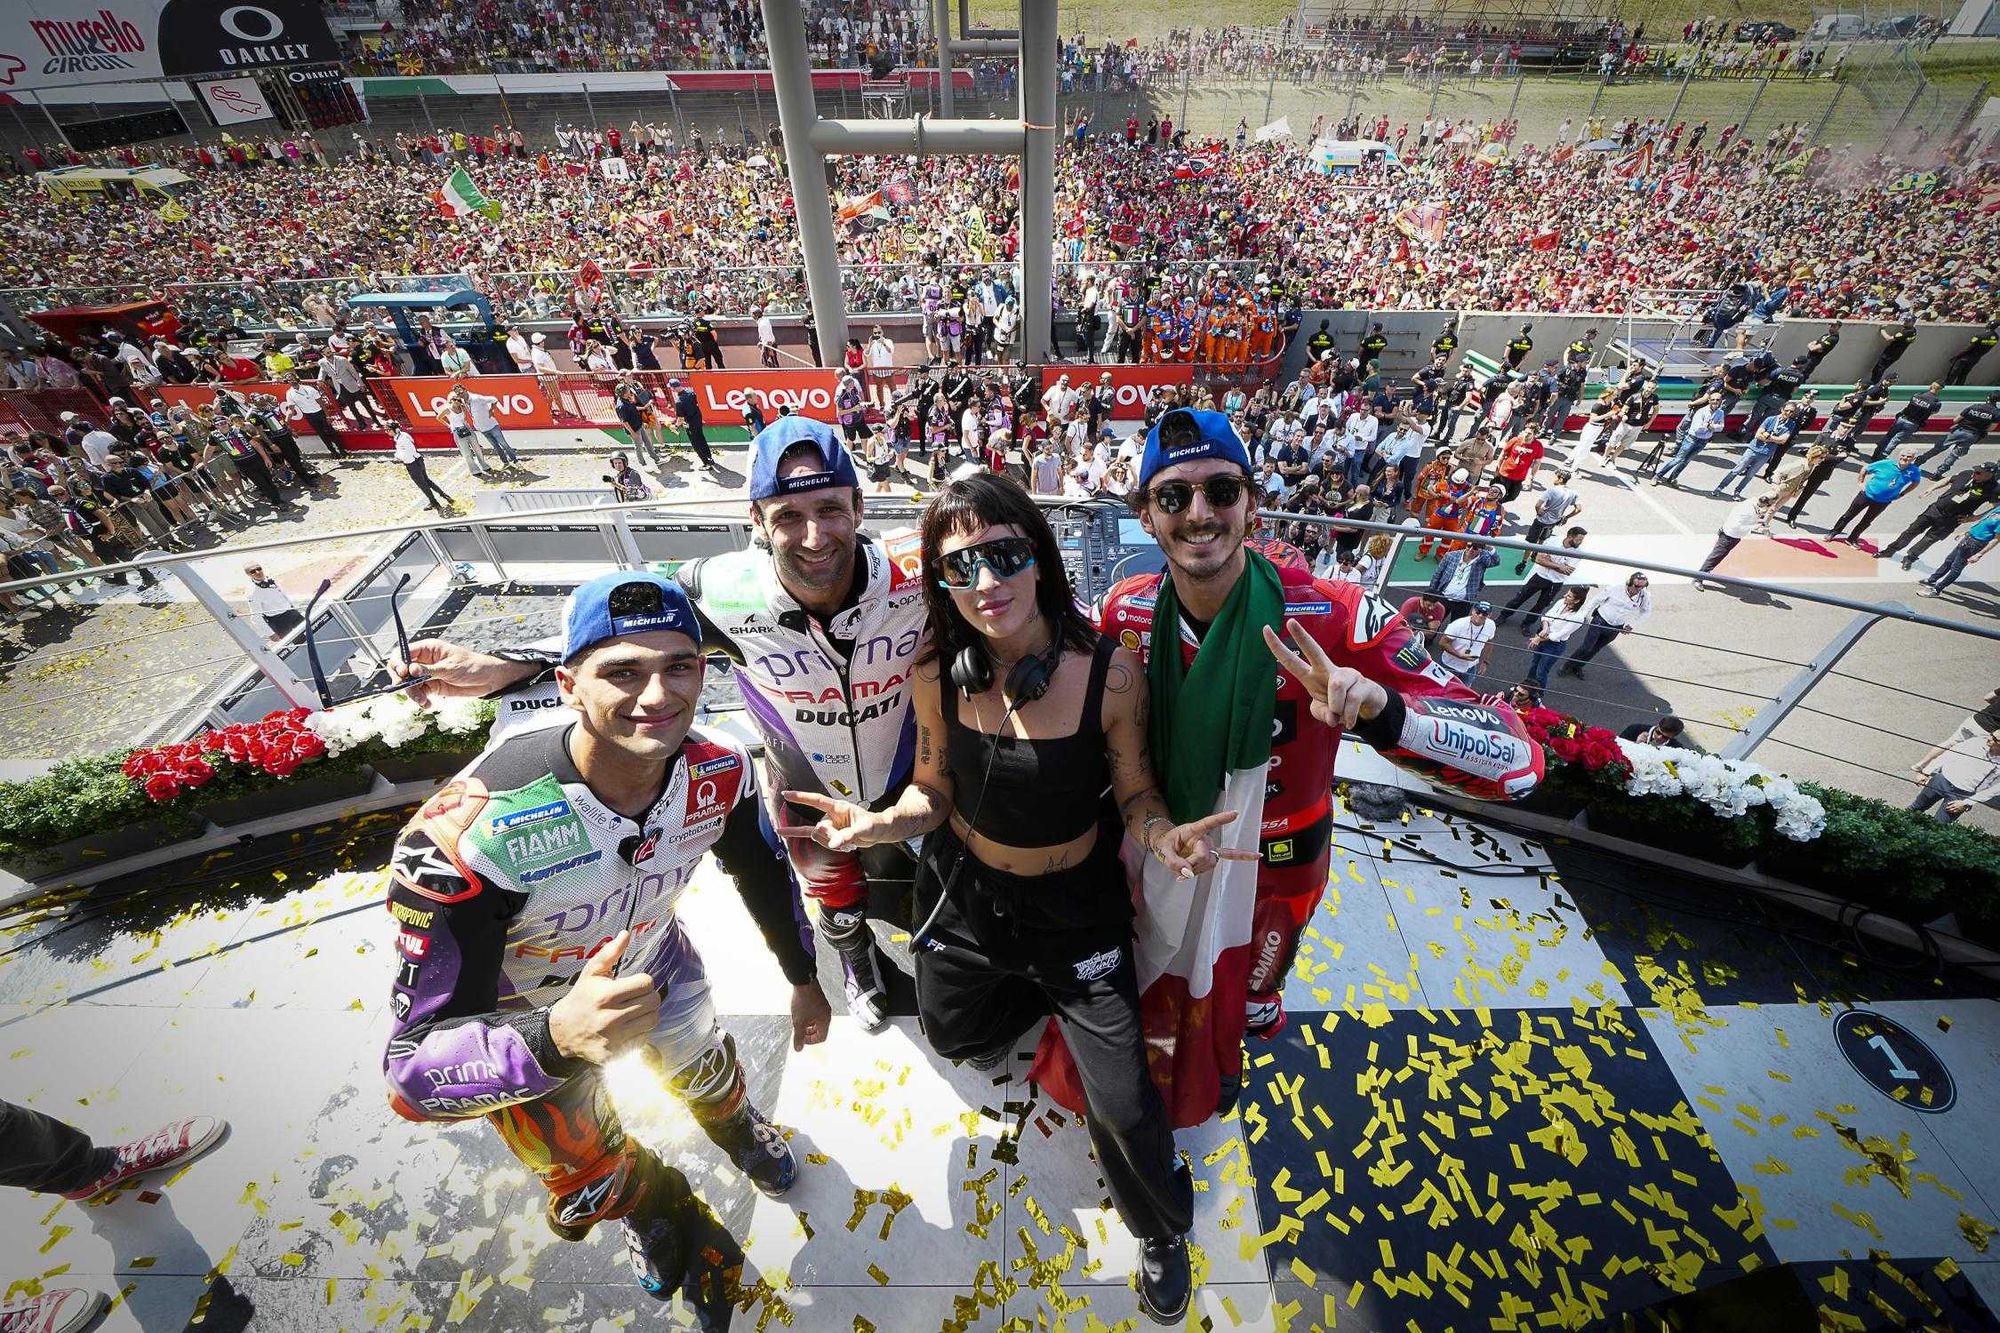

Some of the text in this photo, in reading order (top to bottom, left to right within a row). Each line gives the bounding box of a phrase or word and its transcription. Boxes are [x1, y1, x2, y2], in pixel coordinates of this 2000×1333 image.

[28, 10, 145, 56] mugello
[42, 54, 135, 75] CIRCUIT
[219, 44, 310, 65] OAKLEY
[305, 70, 340, 80] OAKLEY
[1777, 373, 1799, 384] POLIZIA
[1968, 409, 1993, 421] POLIZIA
[1169, 443, 1210, 459] MICHELIN
[788, 477, 830, 489] MICHELIN
[622, 617, 675, 628] MICHELIN
[729, 625, 775, 635] SHARK
[796, 691, 902, 728] DUCATI
[1433, 719, 1516, 764] UnipolSai
[705, 760, 735, 772] MICHELIN
[509, 806, 563, 826] MICHELIN
[575, 795, 607, 825] wallife
[686, 802, 726, 822] PRAMAC
[505, 821, 580, 867] FIAMM
[1868, 1035, 1920, 1079] 1
